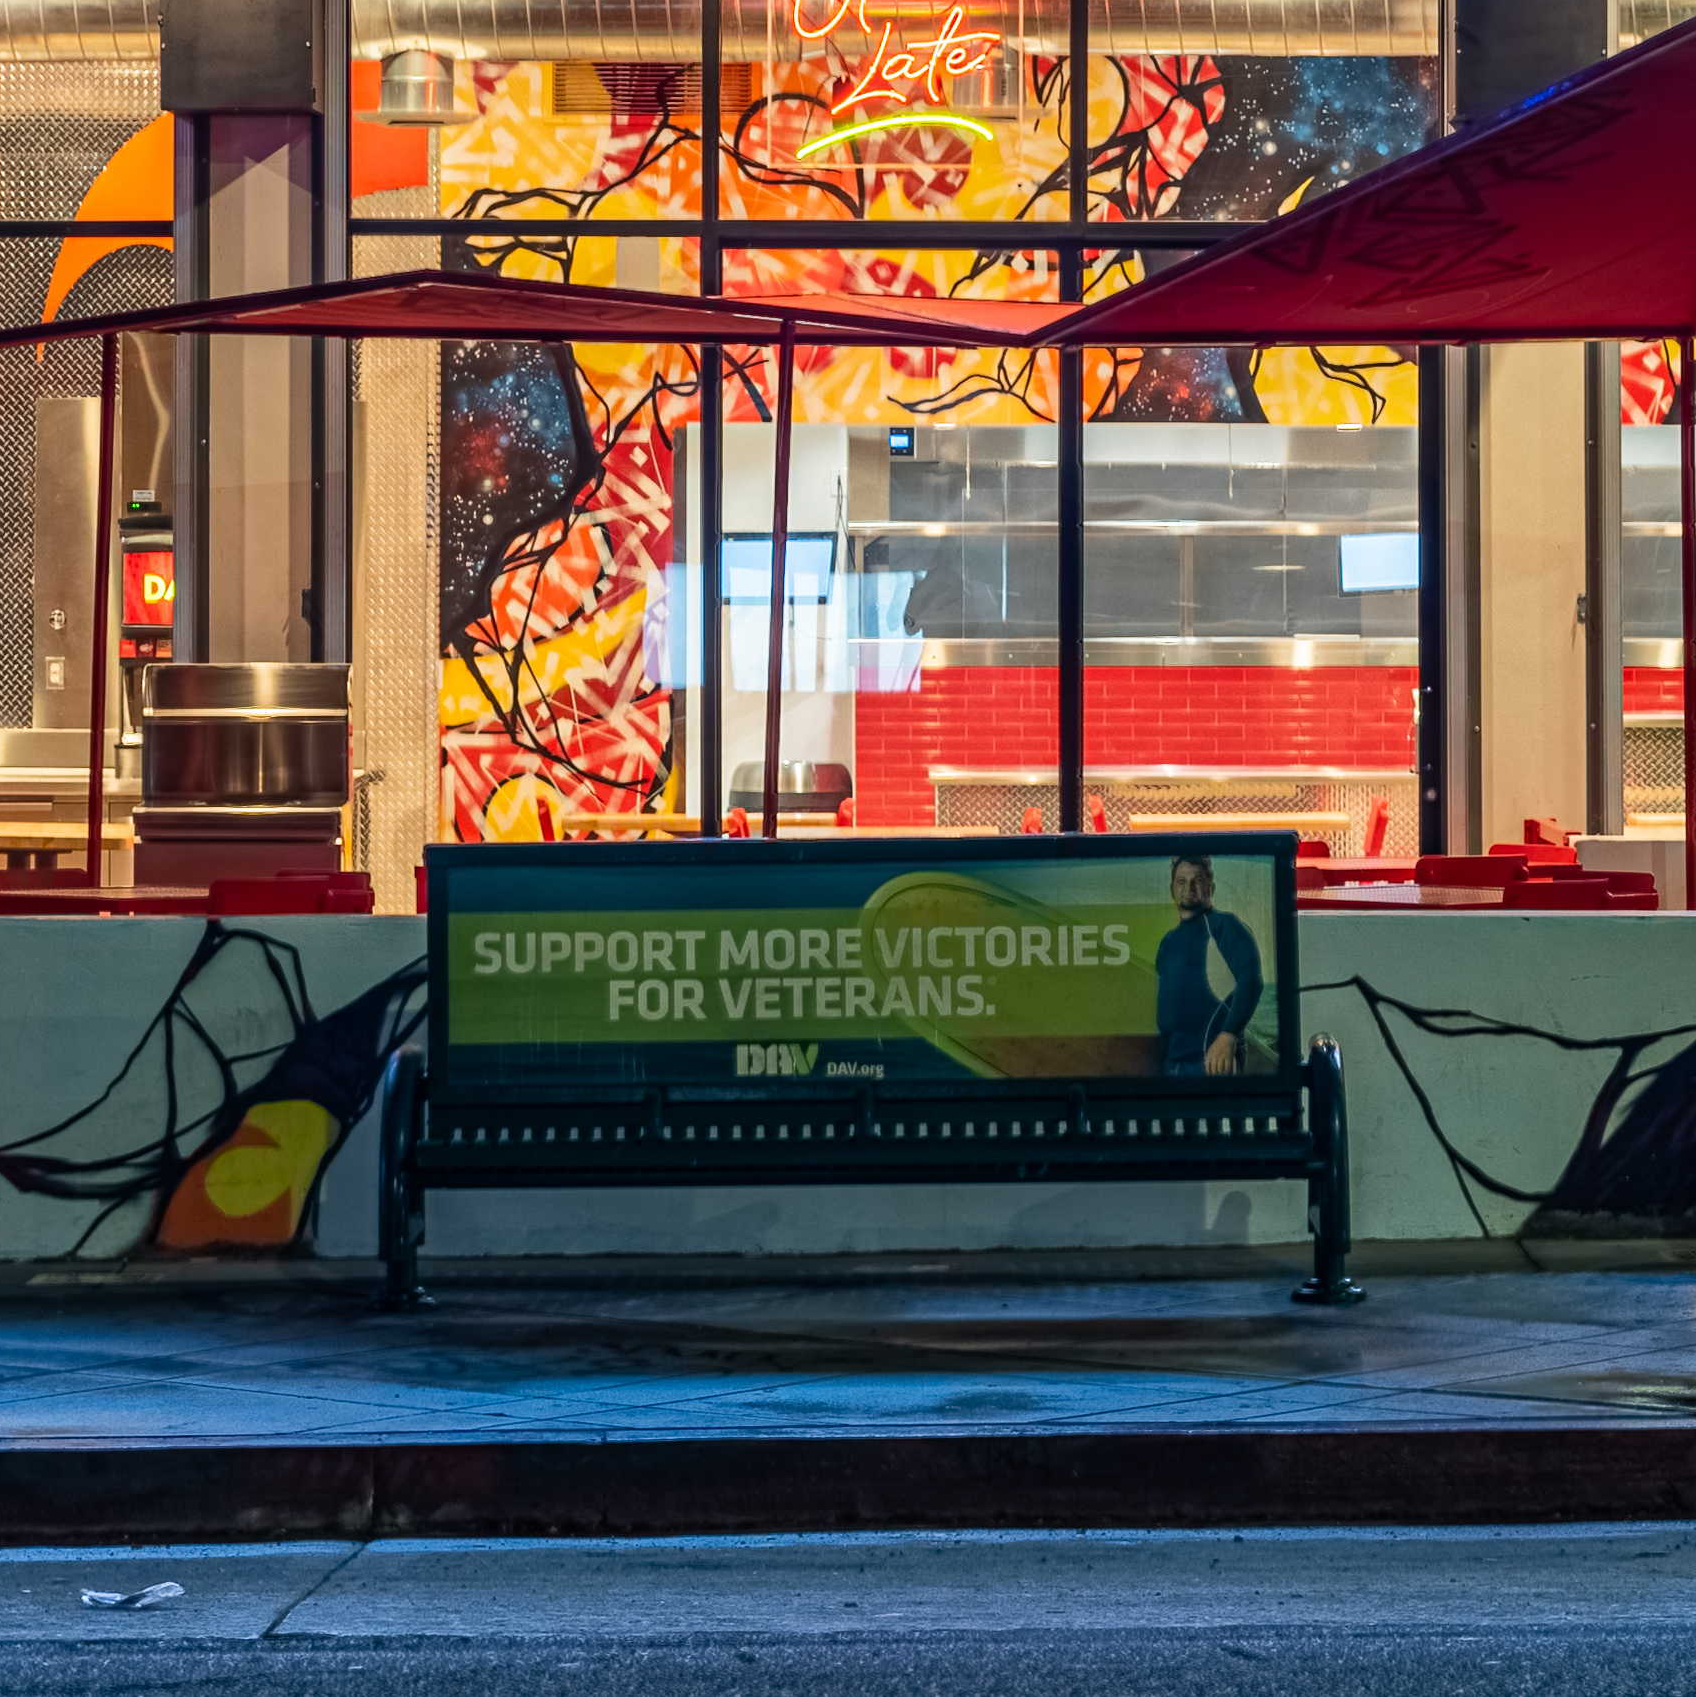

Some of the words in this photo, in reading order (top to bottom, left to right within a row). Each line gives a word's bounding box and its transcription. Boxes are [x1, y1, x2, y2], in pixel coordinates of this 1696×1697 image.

[830, 6, 1002, 116] Late
[474, 929, 706, 975] SUPPORT
[718, 927, 864, 972] MORE
[875, 923, 1130, 970] VICTORIES
[608, 979, 706, 1022] FOR
[718, 975, 997, 1021] VETERANS.
[736, 1043, 819, 1077] DAV
[826, 1060, 885, 1079] DAV.org
